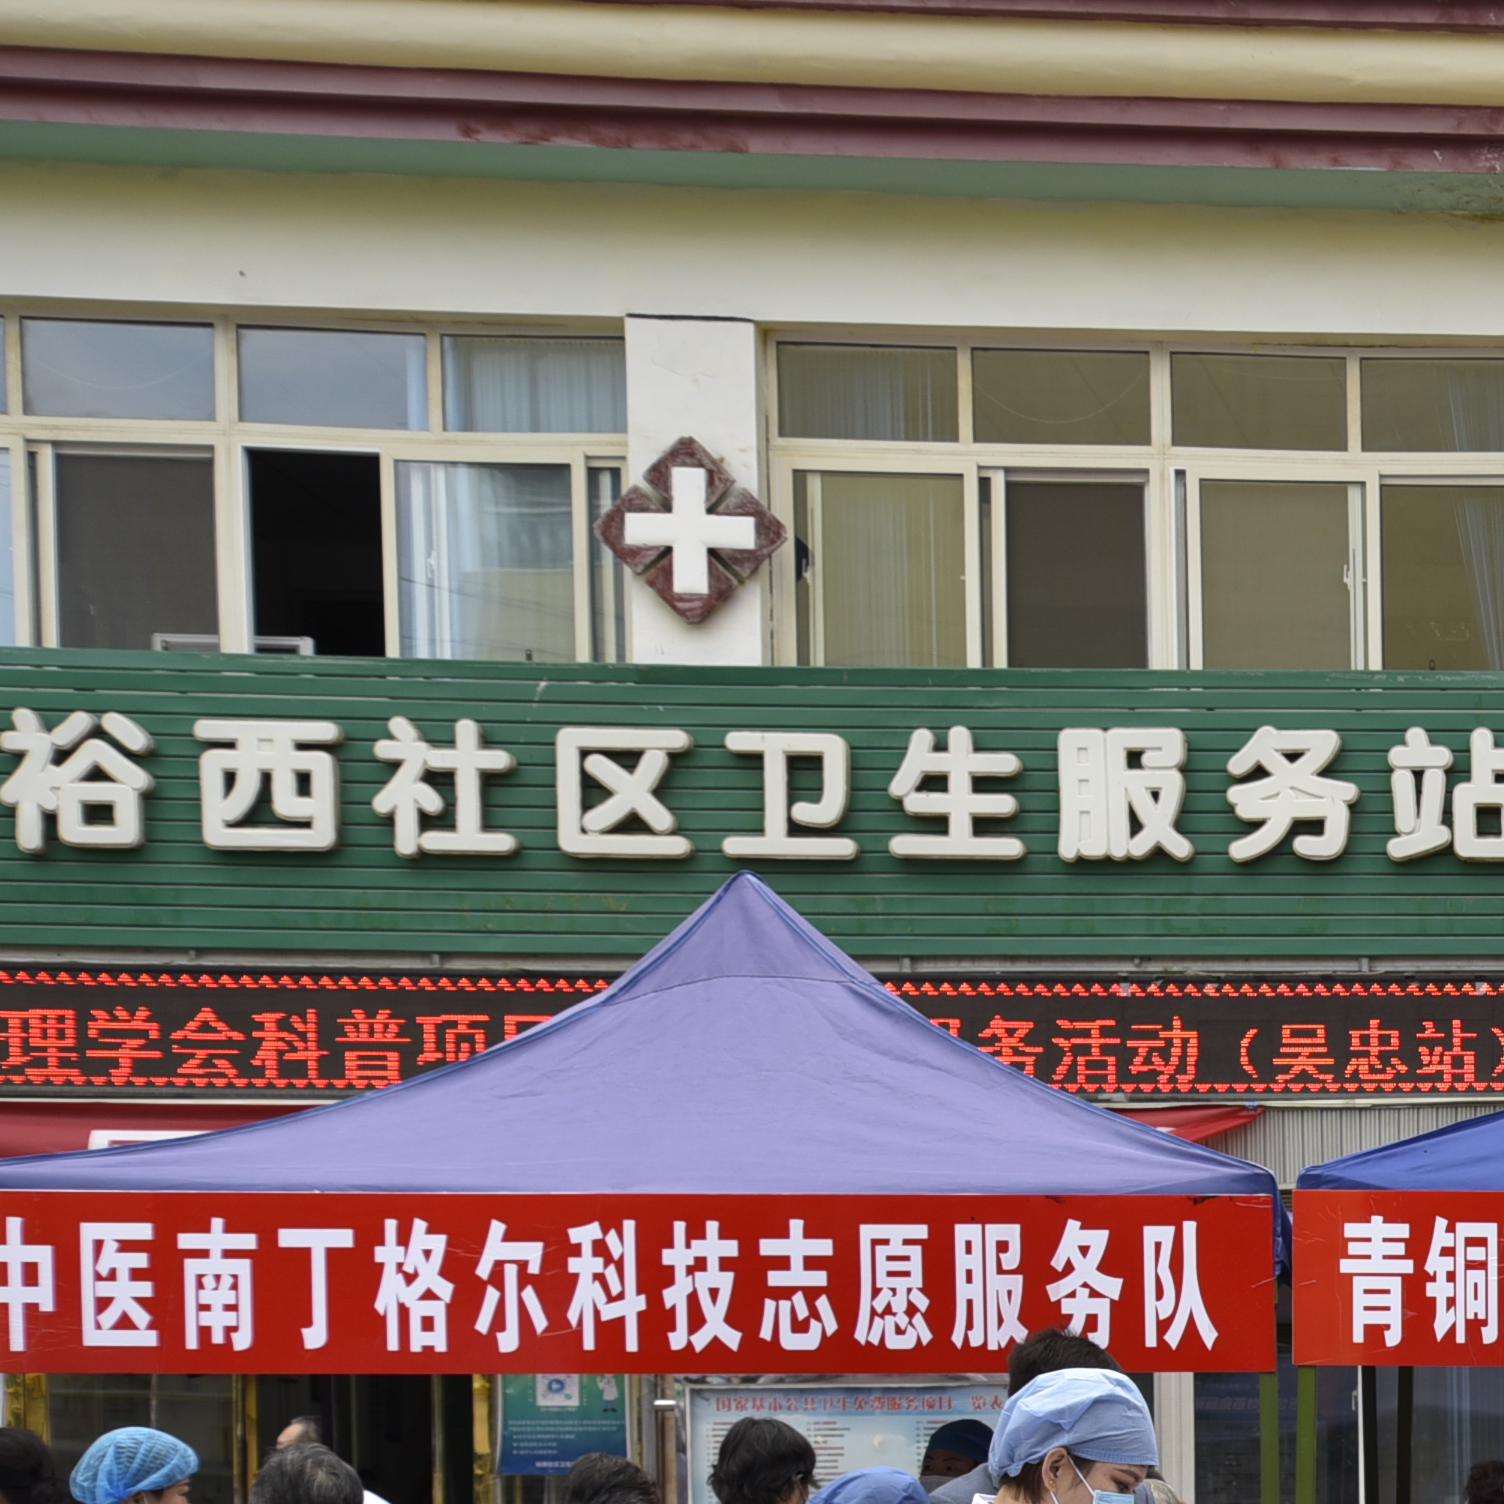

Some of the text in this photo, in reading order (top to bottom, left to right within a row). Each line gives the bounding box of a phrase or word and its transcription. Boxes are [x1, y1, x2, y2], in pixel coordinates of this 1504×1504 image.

[0, 1006, 552, 1077] 理学会科普项
[0, 1217, 1219, 1354] 中医南丁格尔科技志愿服务队
